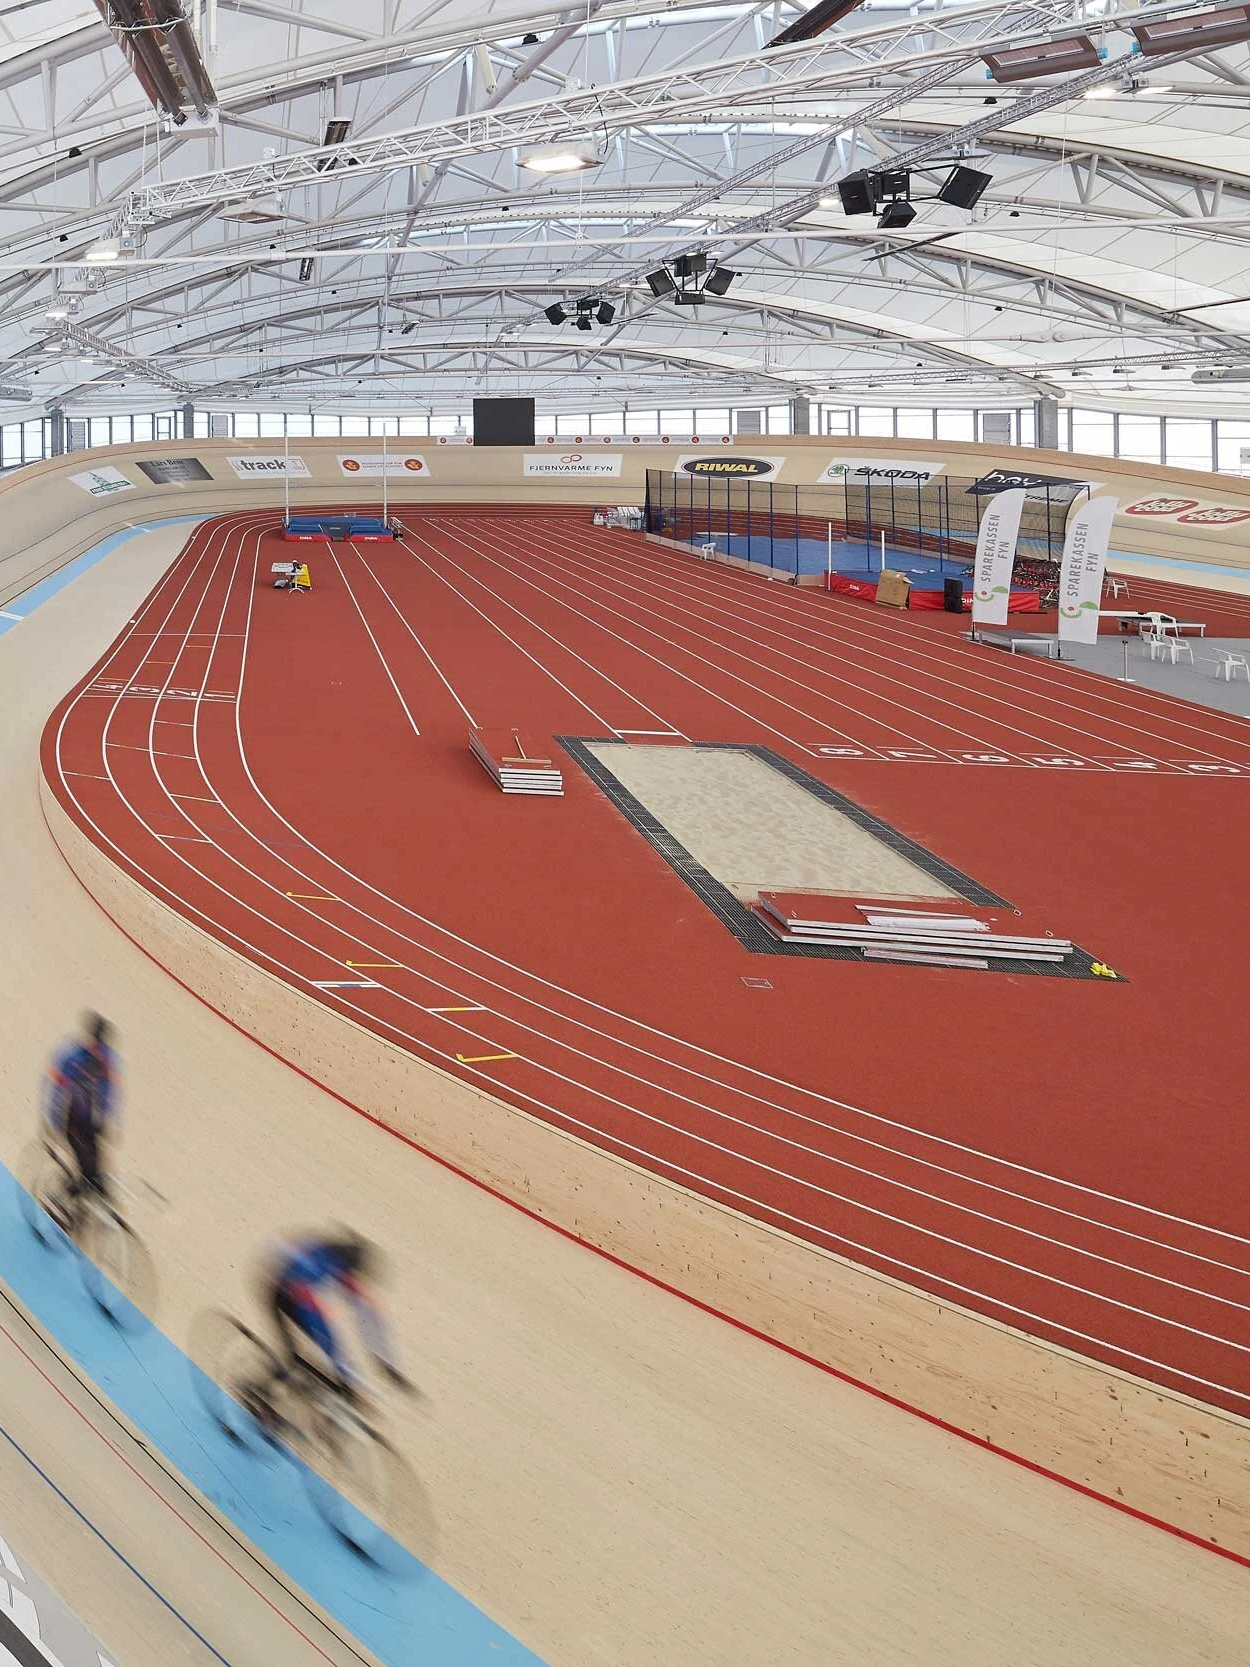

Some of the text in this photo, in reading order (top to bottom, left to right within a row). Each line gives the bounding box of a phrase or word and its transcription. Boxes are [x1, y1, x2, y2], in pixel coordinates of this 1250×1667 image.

[241, 459, 286, 471] track
[694, 462, 759, 474] RIWAL
[853, 465, 931, 481] ŠKODA
[980, 513, 1001, 583] SPAREKASSEN
[998, 540, 1010, 560] FYN
[1067, 522, 1089, 597] SPAREKASSEN
[1085, 551, 1099, 573] FYN
[819, 747, 864, 756] 8
[887, 750, 937, 759] 7
[1032, 757, 1084, 766] 5
[1187, 763, 1241, 774] 3
